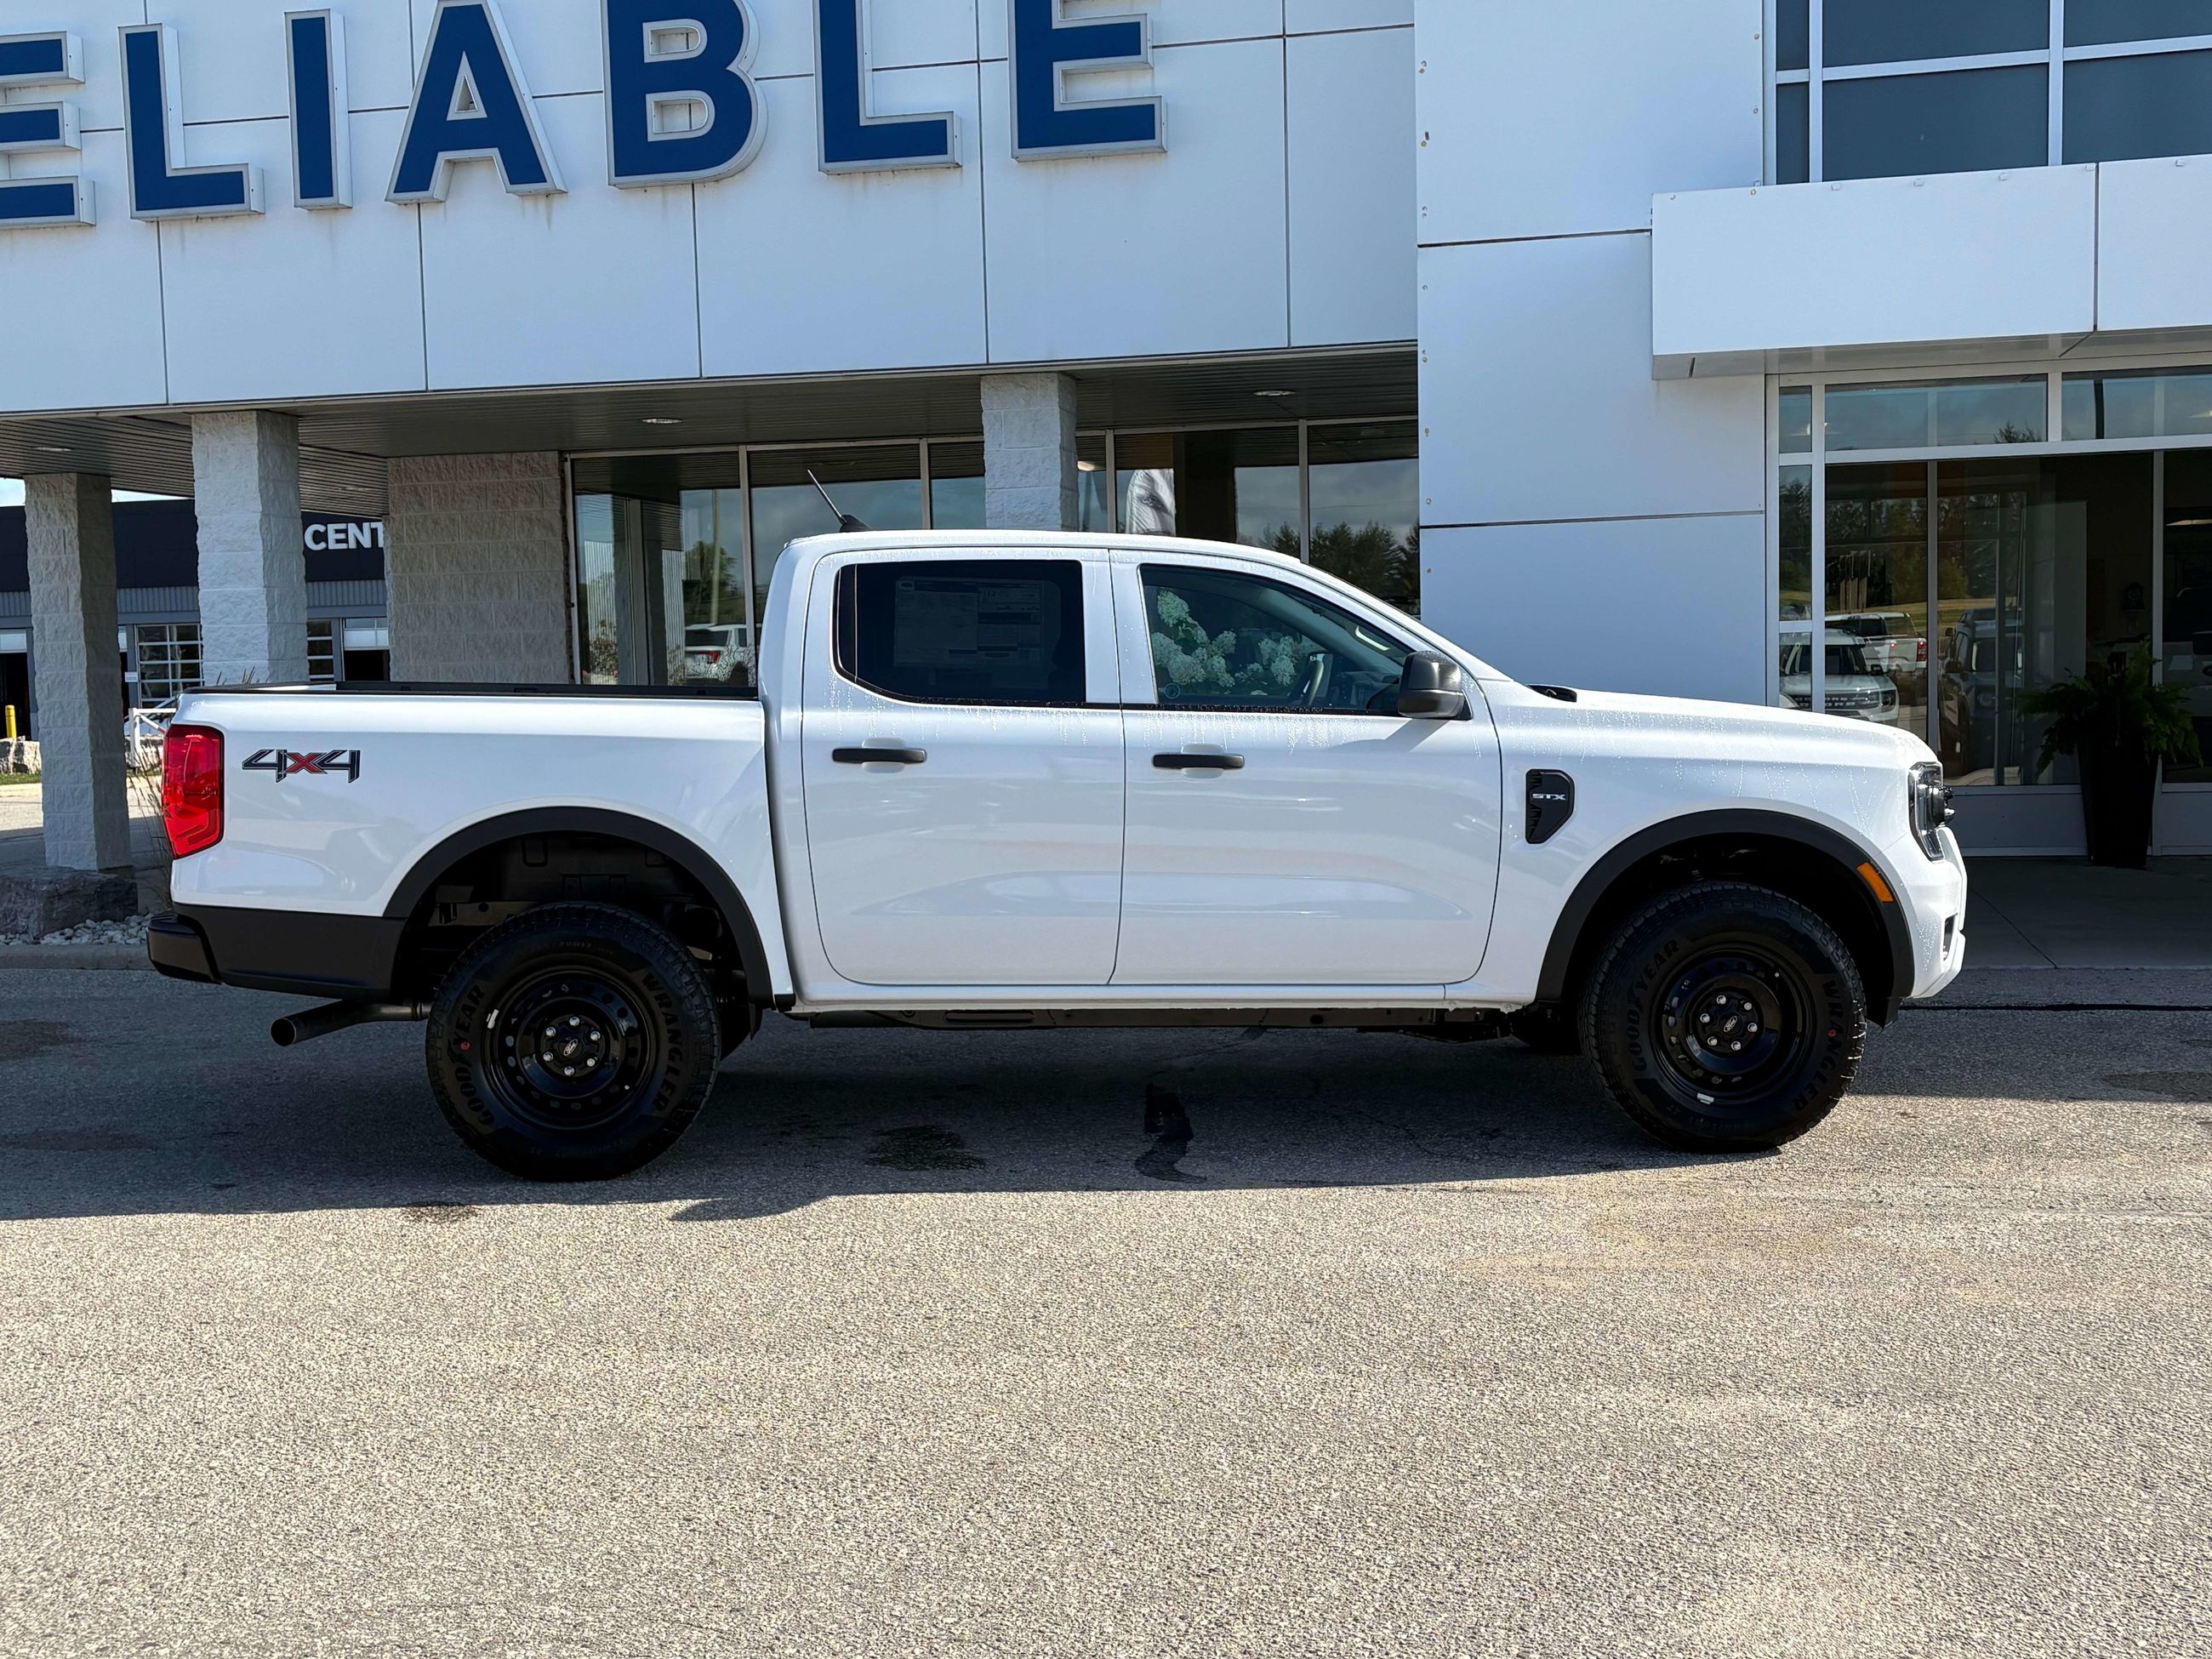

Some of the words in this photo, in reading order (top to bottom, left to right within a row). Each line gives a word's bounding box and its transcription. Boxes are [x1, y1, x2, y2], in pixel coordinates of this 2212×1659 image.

[448, 984, 495, 1126] GOODYEAR
[642, 972, 682, 1111] WRANGLER
[1627, 938, 1679, 1072] GOODYEAR
[1790, 979, 1844, 1111] WRANGLER
